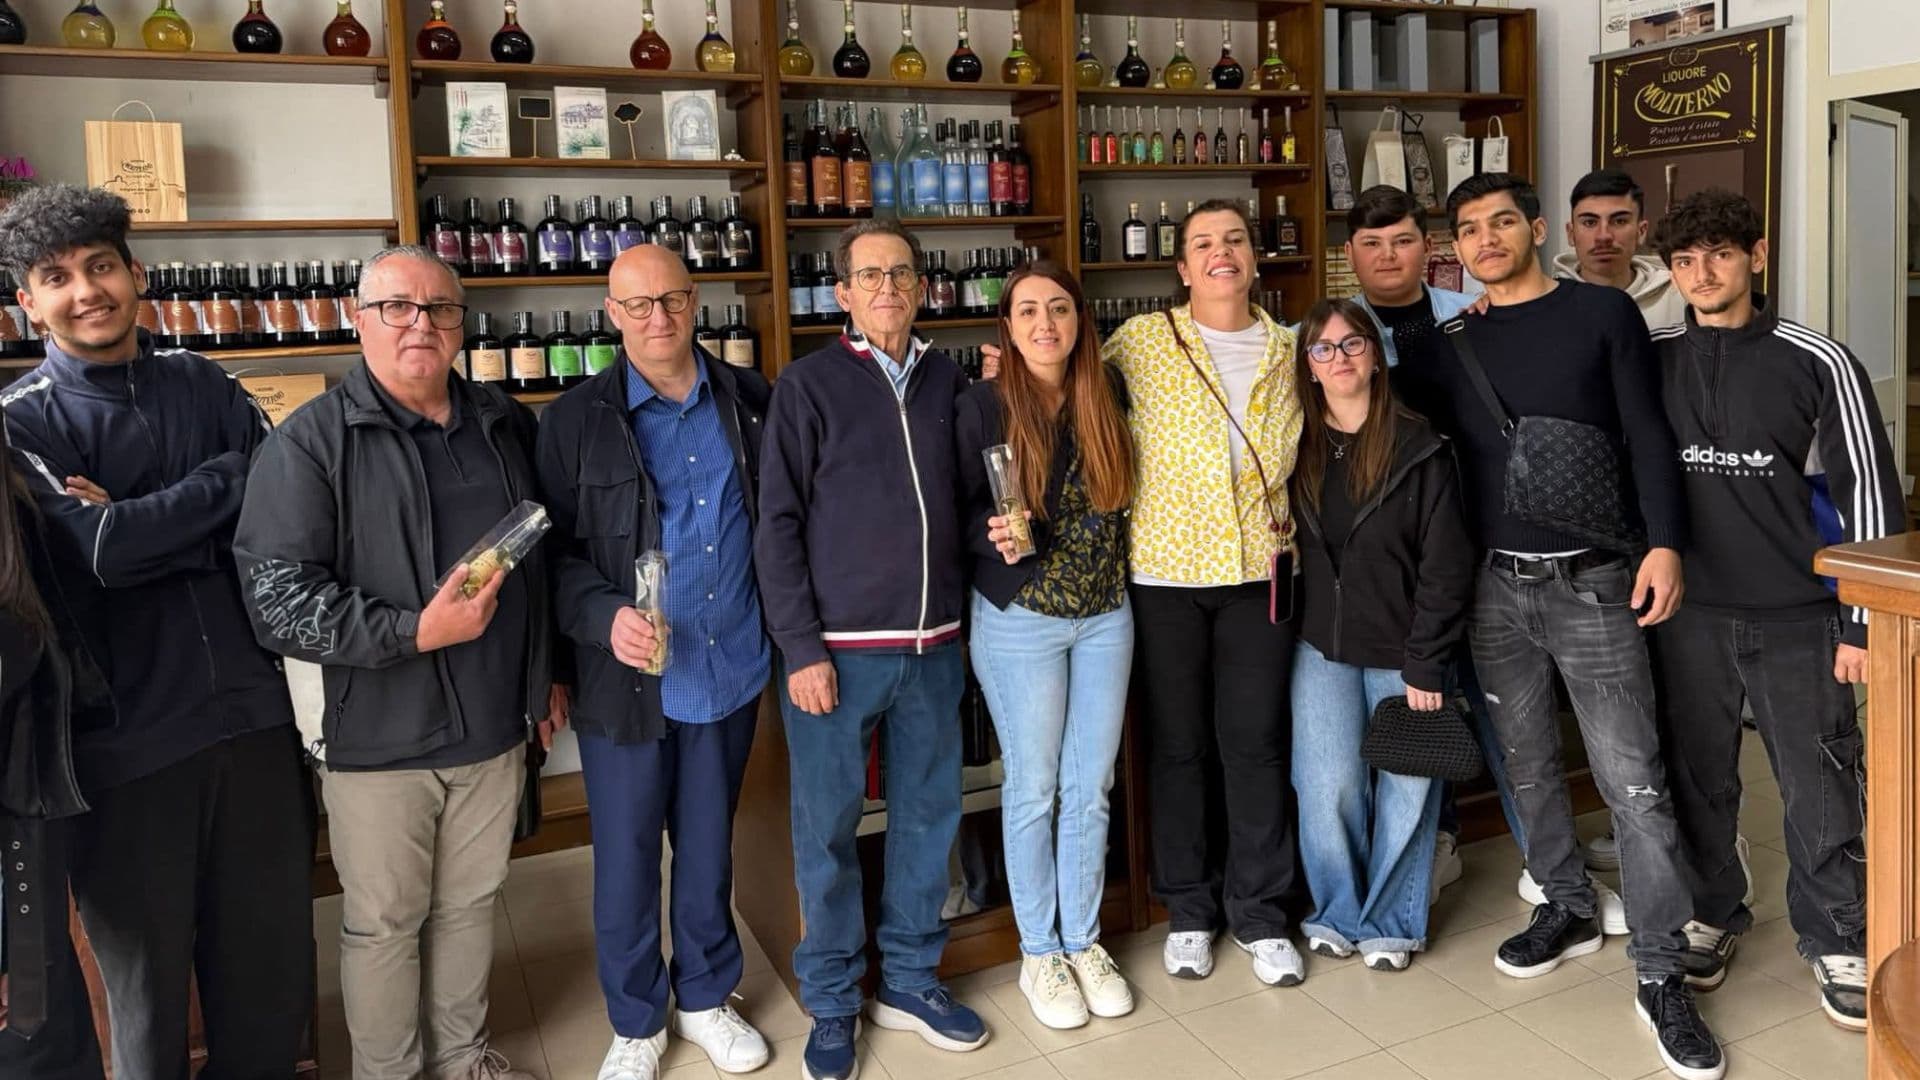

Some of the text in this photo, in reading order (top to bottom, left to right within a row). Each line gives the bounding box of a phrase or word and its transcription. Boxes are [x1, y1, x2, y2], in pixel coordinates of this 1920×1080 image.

[1662, 65, 1707, 83] LIQUORE
[1638, 72, 1731, 116] MOLITERNO
[1680, 444, 1740, 467] didas
[1684, 465, 1775, 478] ATEBOARDING
